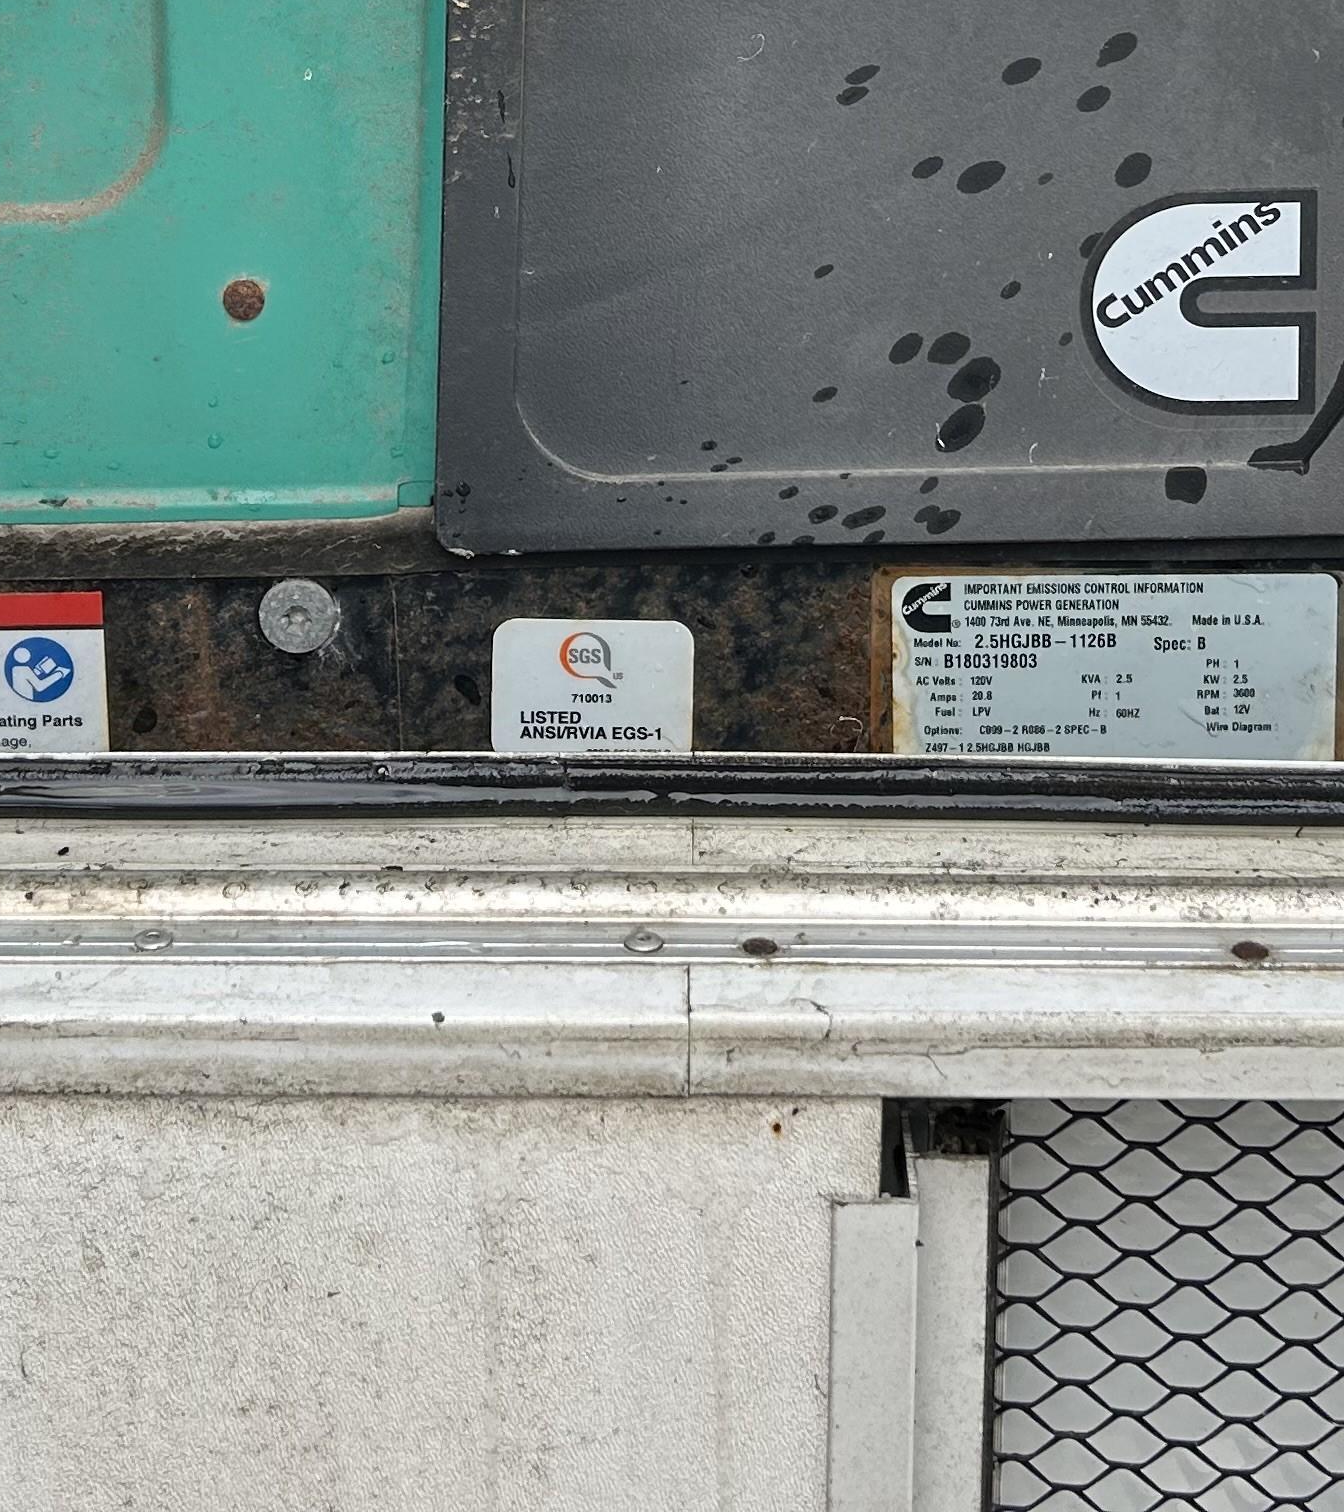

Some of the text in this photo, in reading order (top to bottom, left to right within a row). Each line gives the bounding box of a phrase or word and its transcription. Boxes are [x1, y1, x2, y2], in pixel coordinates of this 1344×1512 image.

[1096, 201, 1281, 328] Cummins
[963, 581, 1204, 595] IMPORTANT EMISSIONS CONTROL INFORMATION
[902, 581, 948, 616] Cummins
[963, 598, 1120, 611] CUMMINS POWER GENERATION
[964, 615, 986, 627] 1400
[990, 615, 1010, 627] 73rd
[1013, 615, 1035, 627] Ave.
[1038, 615, 1054, 628] NE,
[1057, 615, 1118, 628] Minneapolis,
[1121, 615, 1138, 627] MN
[1192, 614, 1219, 626] Made
[1222, 614, 1231, 626] in
[913, 637, 943, 648] Model
[1153, 636, 1192, 653] Spec:
[1197, 636, 1207, 650] B
[568, 648, 602, 664] SGS
[914, 656, 932, 668] S/N
[944, 652, 1038, 669] B180319803
[1206, 658, 1220, 669] PH
[1233, 659, 1239, 669] 1
[916, 675, 929, 686] AC
[932, 675, 956, 686] Volts
[970, 675, 993, 686] 120V
[1081, 673, 1101, 684] KVA
[1115, 673, 1133, 684] 2.5
[1203, 674, 1220, 685] KW
[1233, 674, 1248, 684] 2.5
[571, 693, 612, 704] 710013
[929, 692, 957, 704] Amps
[972, 690, 993, 701] 20.8
[1091, 690, 1102, 700] Pf
[1115, 691, 1120, 701] 1
[1196, 689, 1220, 700] RPM
[1232, 688, 1256, 698] 3600
[935, 706, 956, 717] Fuel
[972, 706, 992, 717] LPV
[1088, 708, 1101, 718] Hz
[1115, 708, 1140, 719] 60HZ
[1204, 705, 1220, 716] Bat
[1233, 704, 1250, 715] 12V
[42, 714, 84, 728] Parts
[519, 710, 582, 725] LISTED
[519, 726, 662, 741] ANSI/RVIA EGS-1
[923, 725, 963, 737] Options:
[1206, 722, 1228, 732] Wire
[1231, 722, 1272, 734] Diagram
[967, 742, 1014, 753] 2.5HGJBB
[1017, 742, 1050, 753] HGJBB
